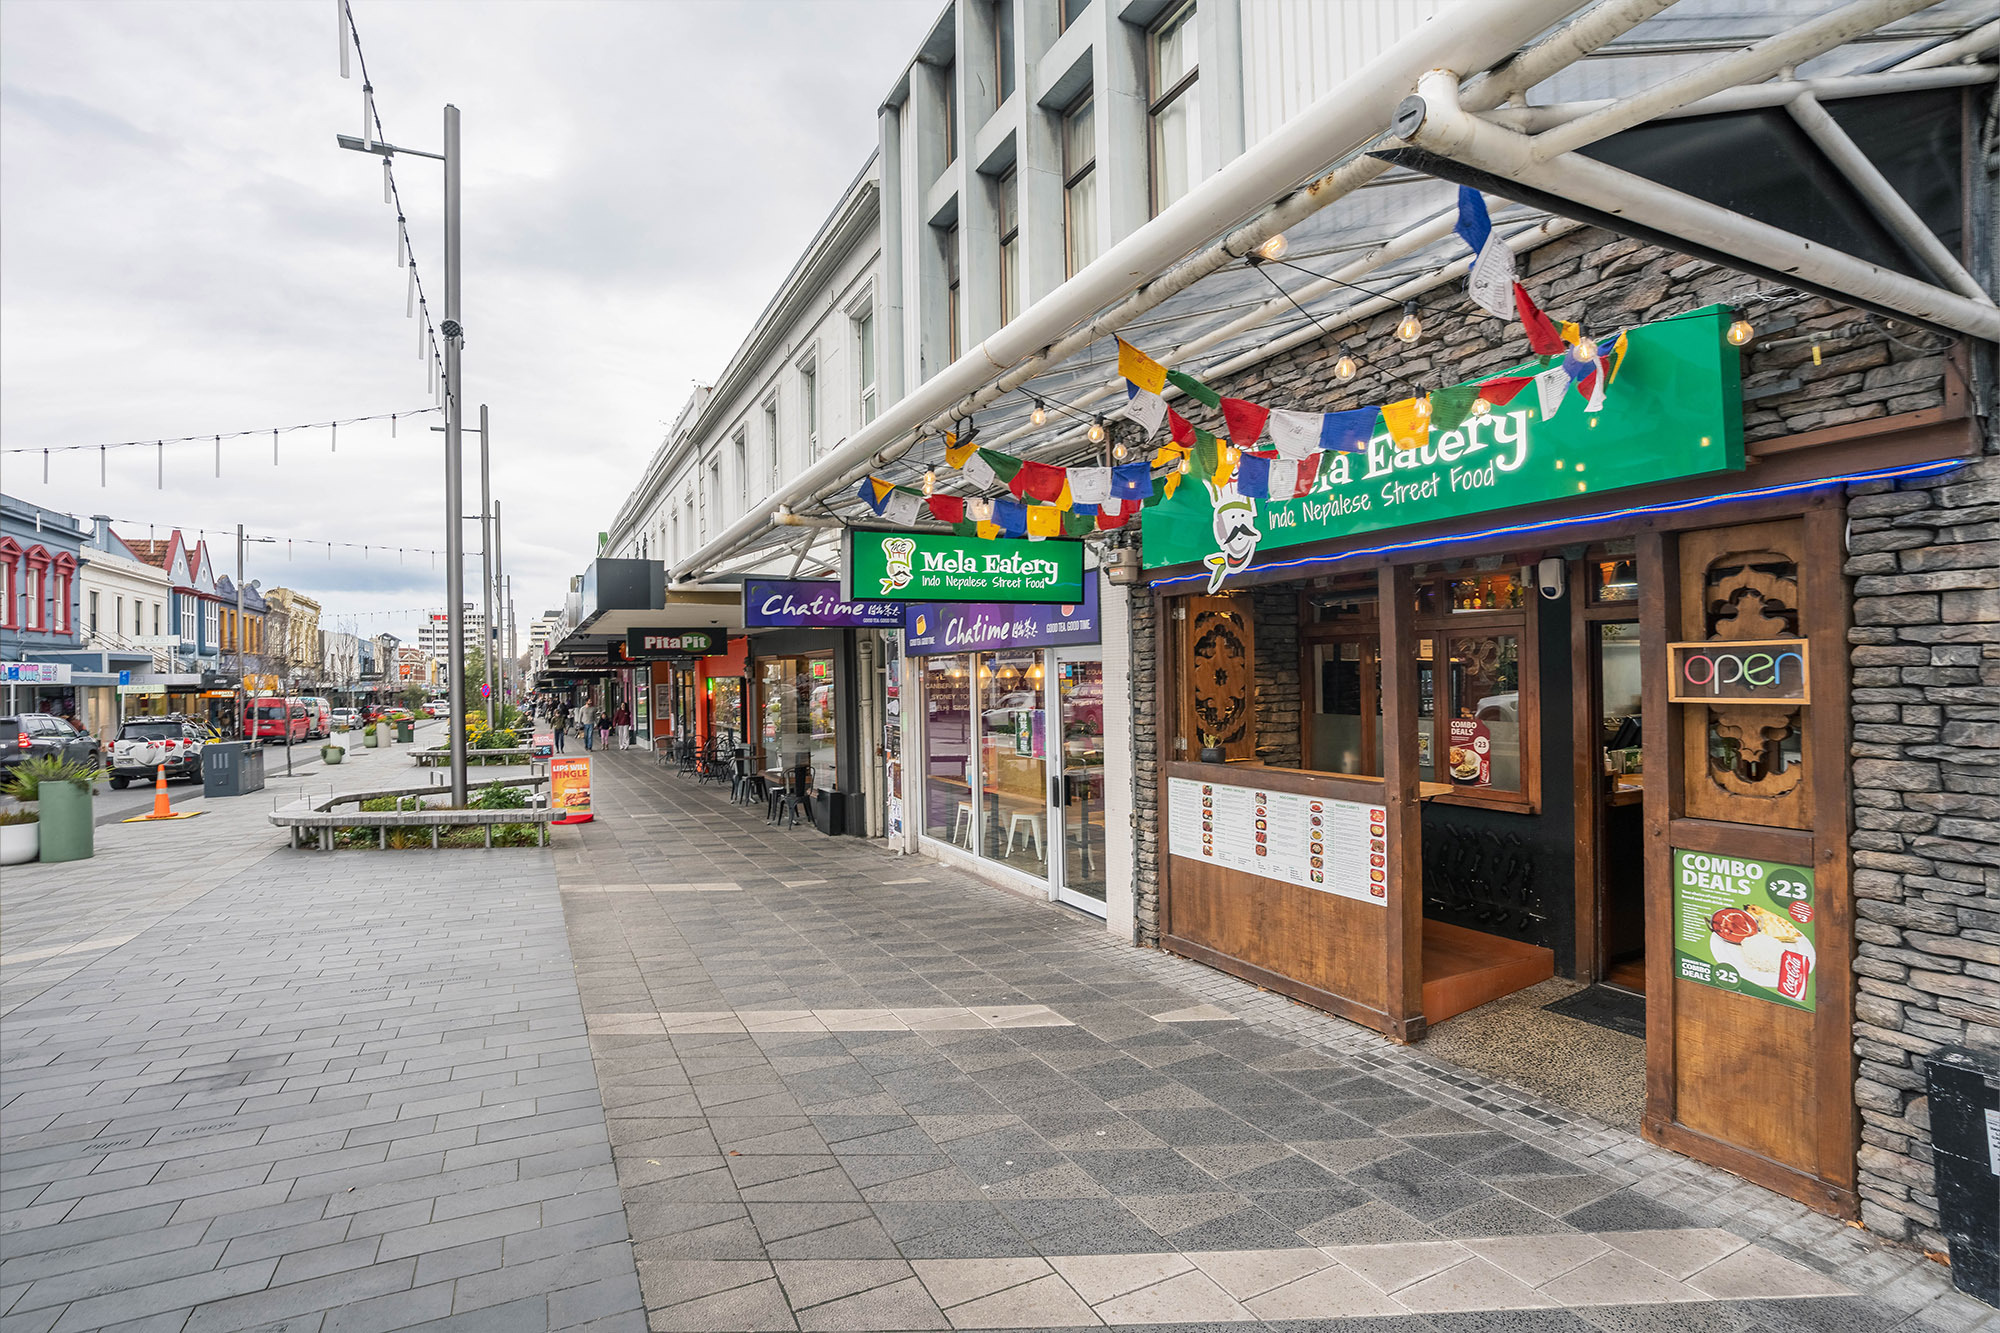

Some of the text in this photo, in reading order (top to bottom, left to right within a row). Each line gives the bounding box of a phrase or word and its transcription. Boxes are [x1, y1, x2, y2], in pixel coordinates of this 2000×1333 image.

[1268, 459, 1495, 531] Indo Nepalese Street Food
[920, 549, 1059, 585] Mela Eatery
[922, 575, 1045, 590] Indo Nepalese Street Food
[761, 594, 865, 616] Chatime
[945, 614, 1009, 646] Chatime
[1046, 623, 1058, 633] GOOD
[1067, 620, 1079, 631] GOOD
[1451, 721, 1477, 729] COMBO
[553, 763, 587, 772] LIPS WILL
[554, 769, 588, 779] TINGLE
[1682, 854, 1763, 880] COMBO
[1769, 879, 1807, 900] $23
[1682, 962, 1711, 975] COMBO
[1682, 969, 1711, 982] DEALS
[1715, 969, 1738, 984] $25
